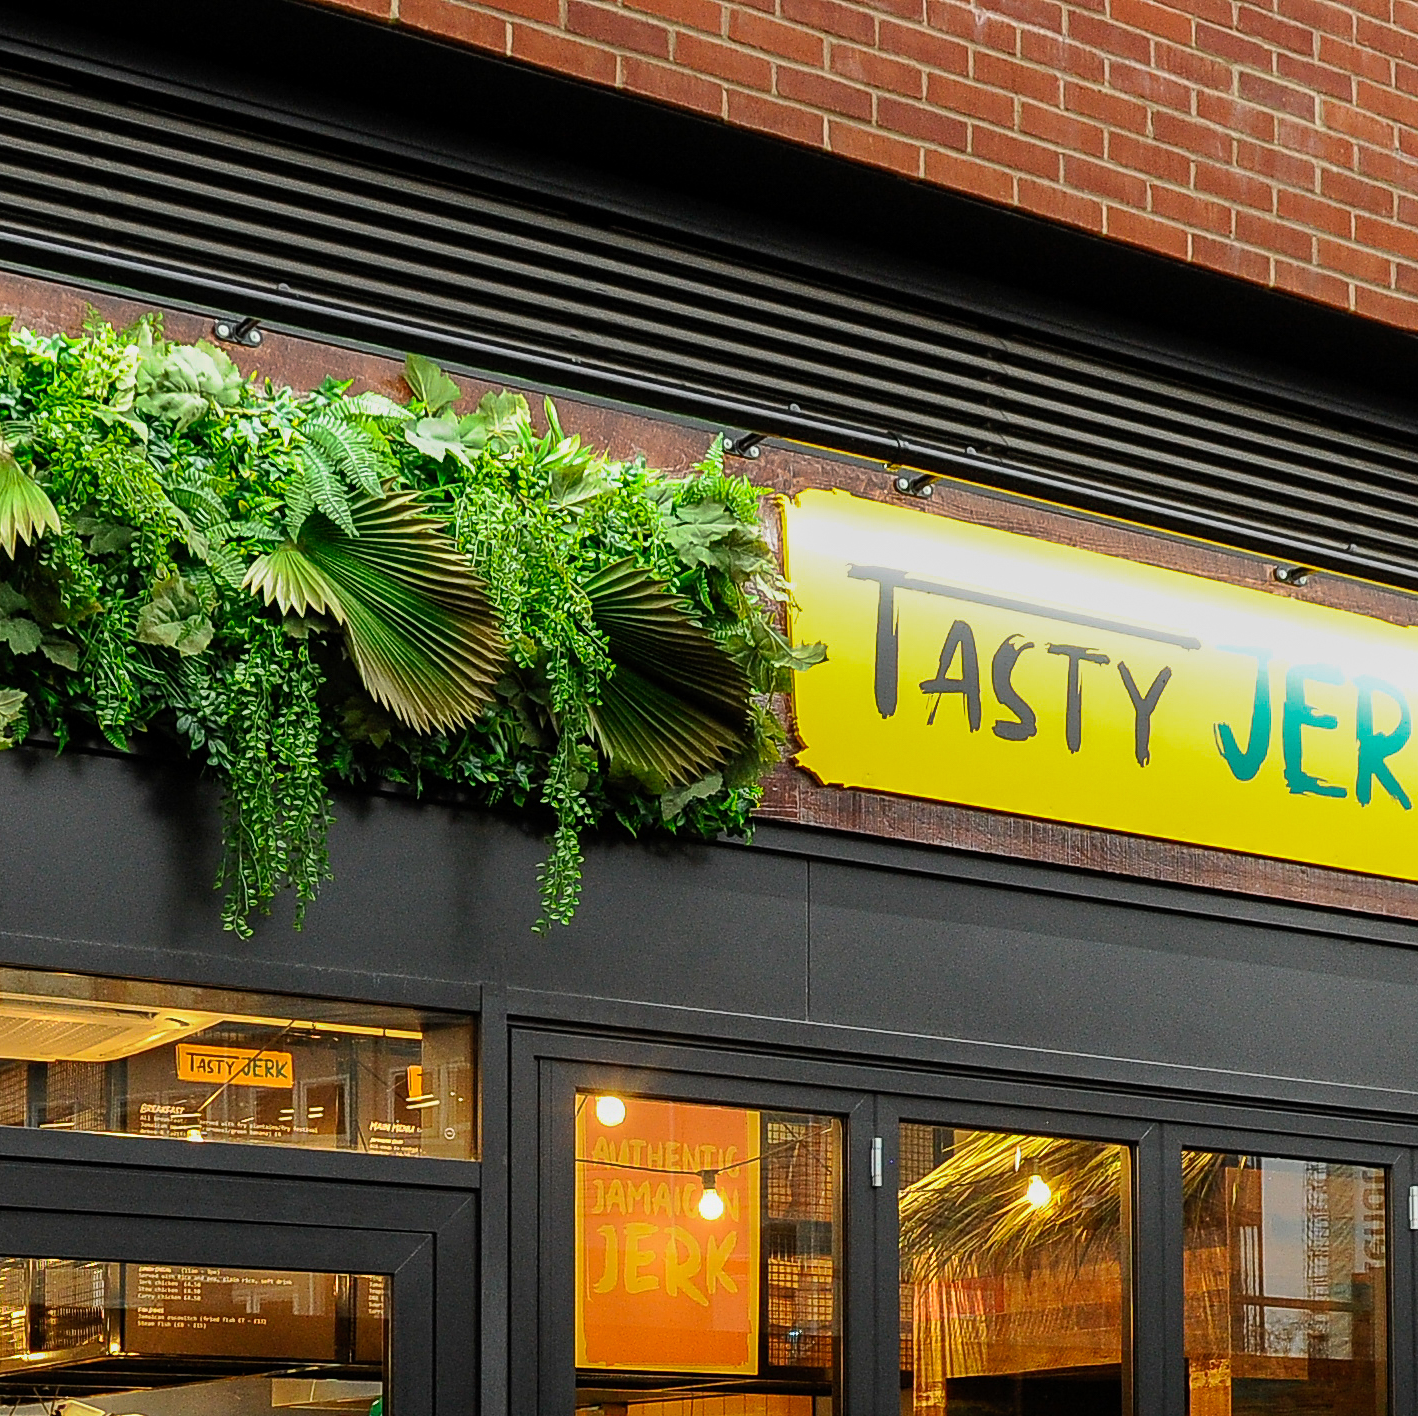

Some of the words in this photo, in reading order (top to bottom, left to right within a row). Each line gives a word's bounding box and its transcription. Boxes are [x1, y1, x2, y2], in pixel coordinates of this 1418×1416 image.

[846, 563, 1201, 768] TASTY
[186, 1052, 239, 1075] TASTY
[241, 1057, 288, 1079] JERK
[591, 1135, 741, 1178] AUTHENTIC
[591, 1178, 740, 1222] JAMAICN
[593, 1222, 738, 1307] JERK
